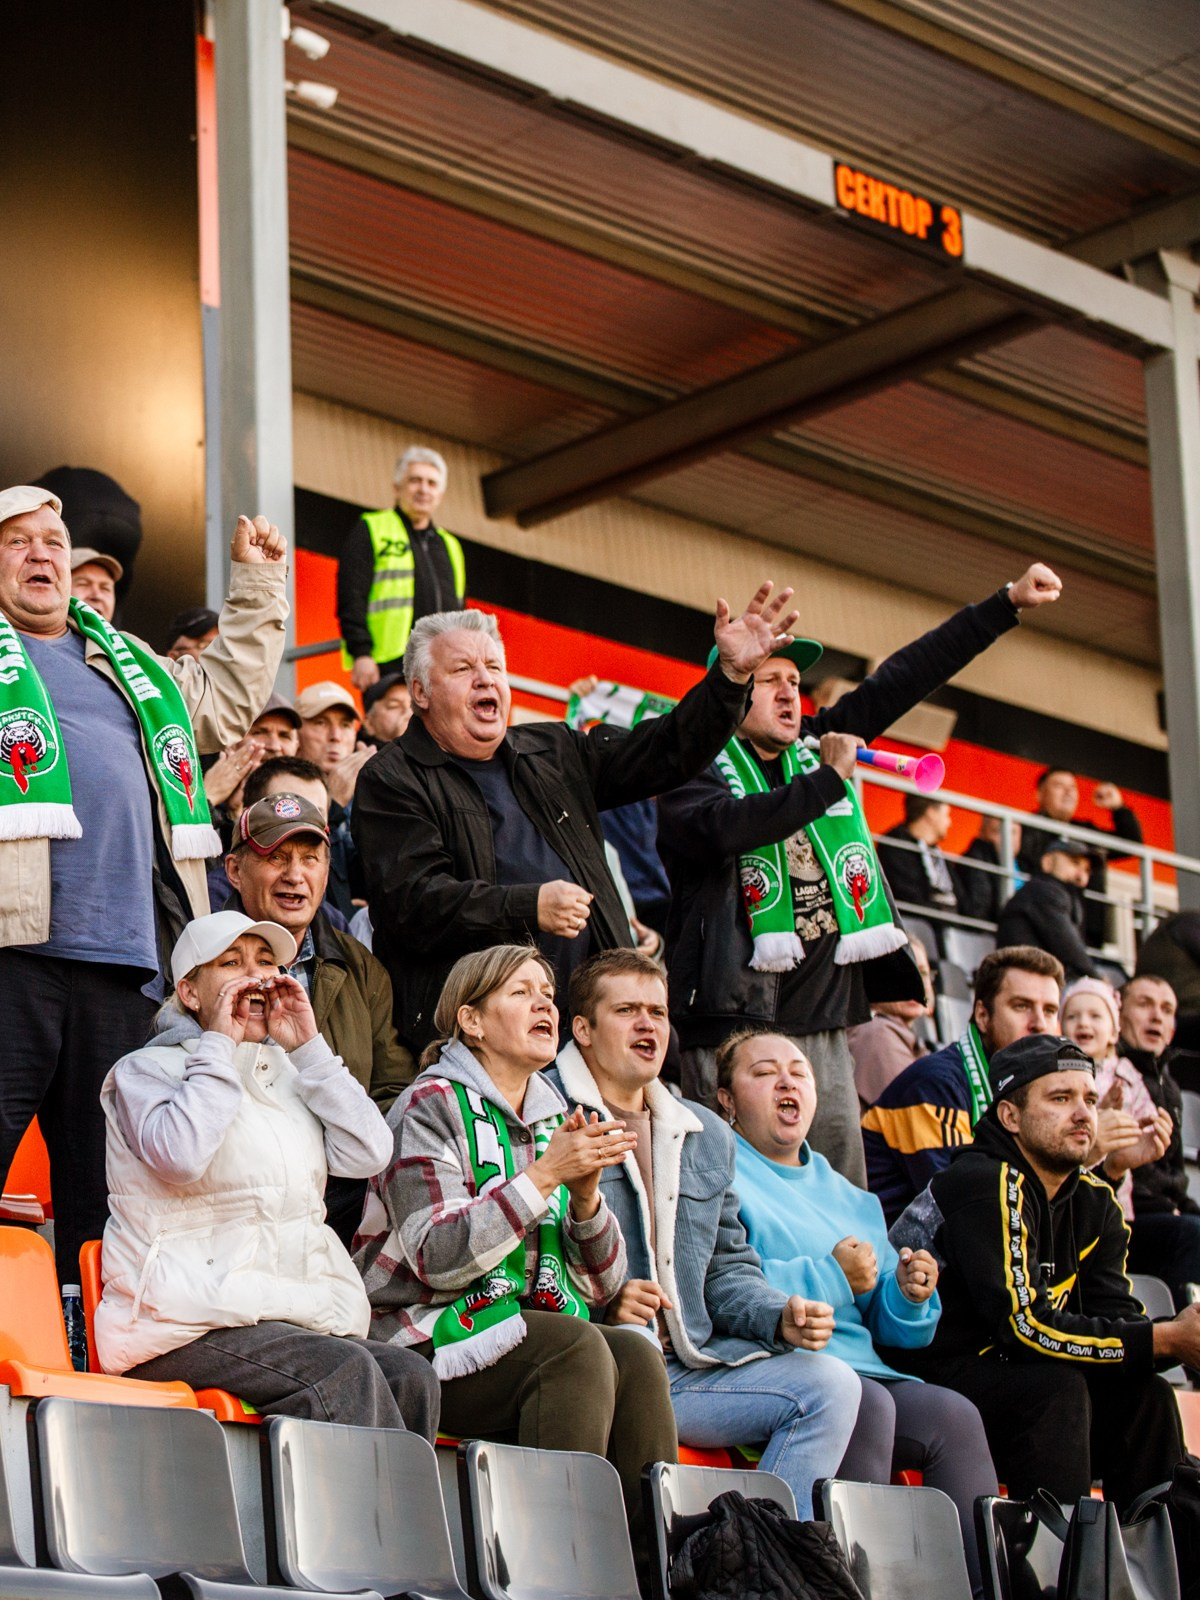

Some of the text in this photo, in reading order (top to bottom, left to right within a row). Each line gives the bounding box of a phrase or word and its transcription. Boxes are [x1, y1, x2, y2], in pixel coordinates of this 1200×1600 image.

[836, 164, 963, 257] СЕКТОР 3
[794, 884, 819, 896] LAGER
[1038, 1333, 1061, 1352] VSVN
[1066, 1342, 1093, 1357] VSVN
[1098, 1348, 1125, 1359] VSVN
